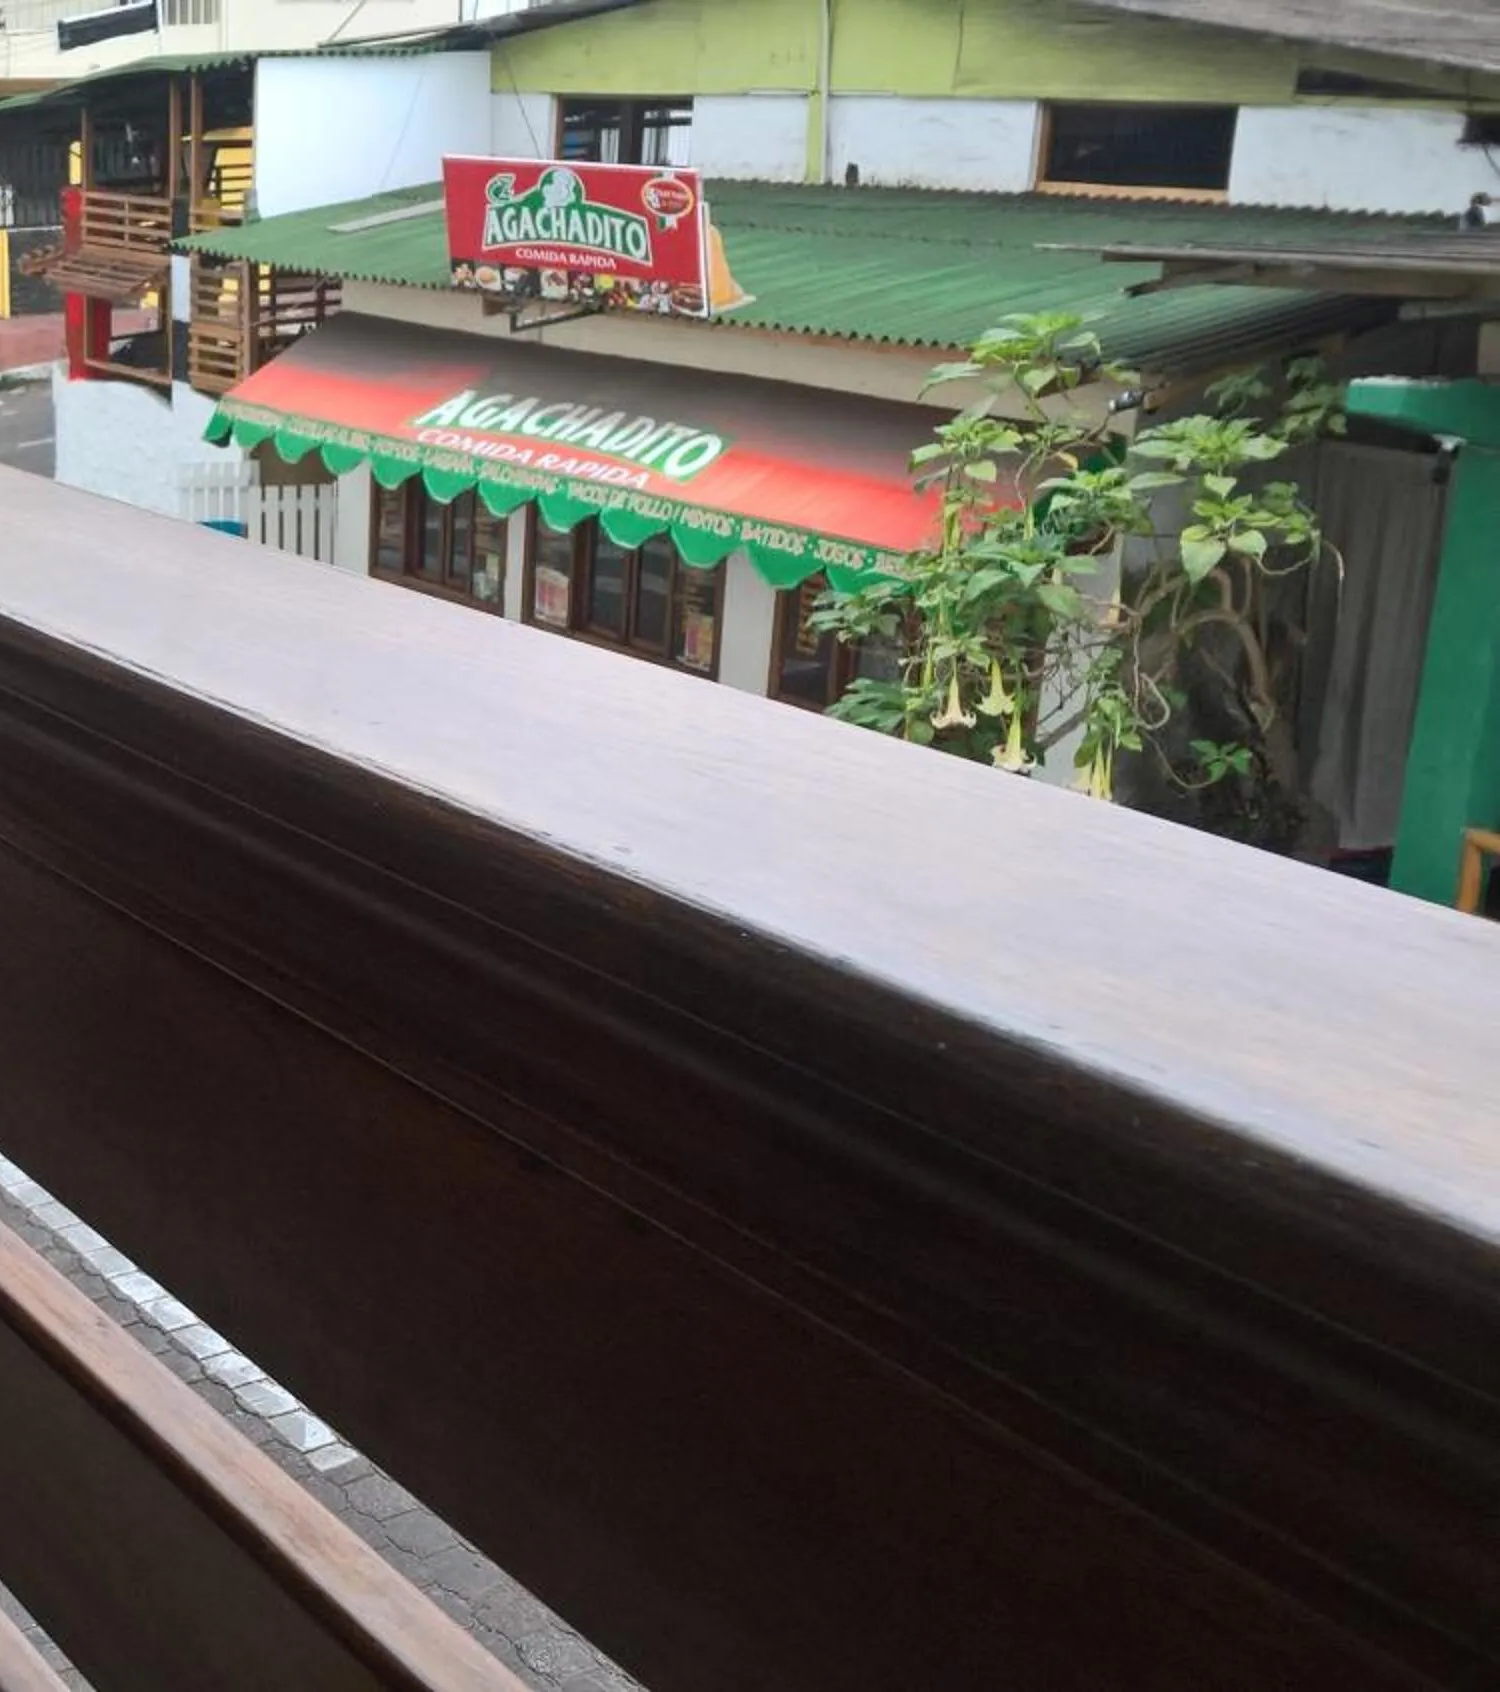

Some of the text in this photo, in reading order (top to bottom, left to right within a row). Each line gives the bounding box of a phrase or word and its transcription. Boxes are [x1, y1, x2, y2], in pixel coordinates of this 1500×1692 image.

[486, 206, 647, 260] AGACHADITO
[515, 247, 617, 270] COMIDA RAPIDA
[414, 389, 723, 478] AGACHADITO
[417, 428, 532, 465] COMIDA
[535, 448, 650, 490] RAPIDA
[628, 491, 673, 522] POLLO
[740, 519, 808, 557] BATIDOS
